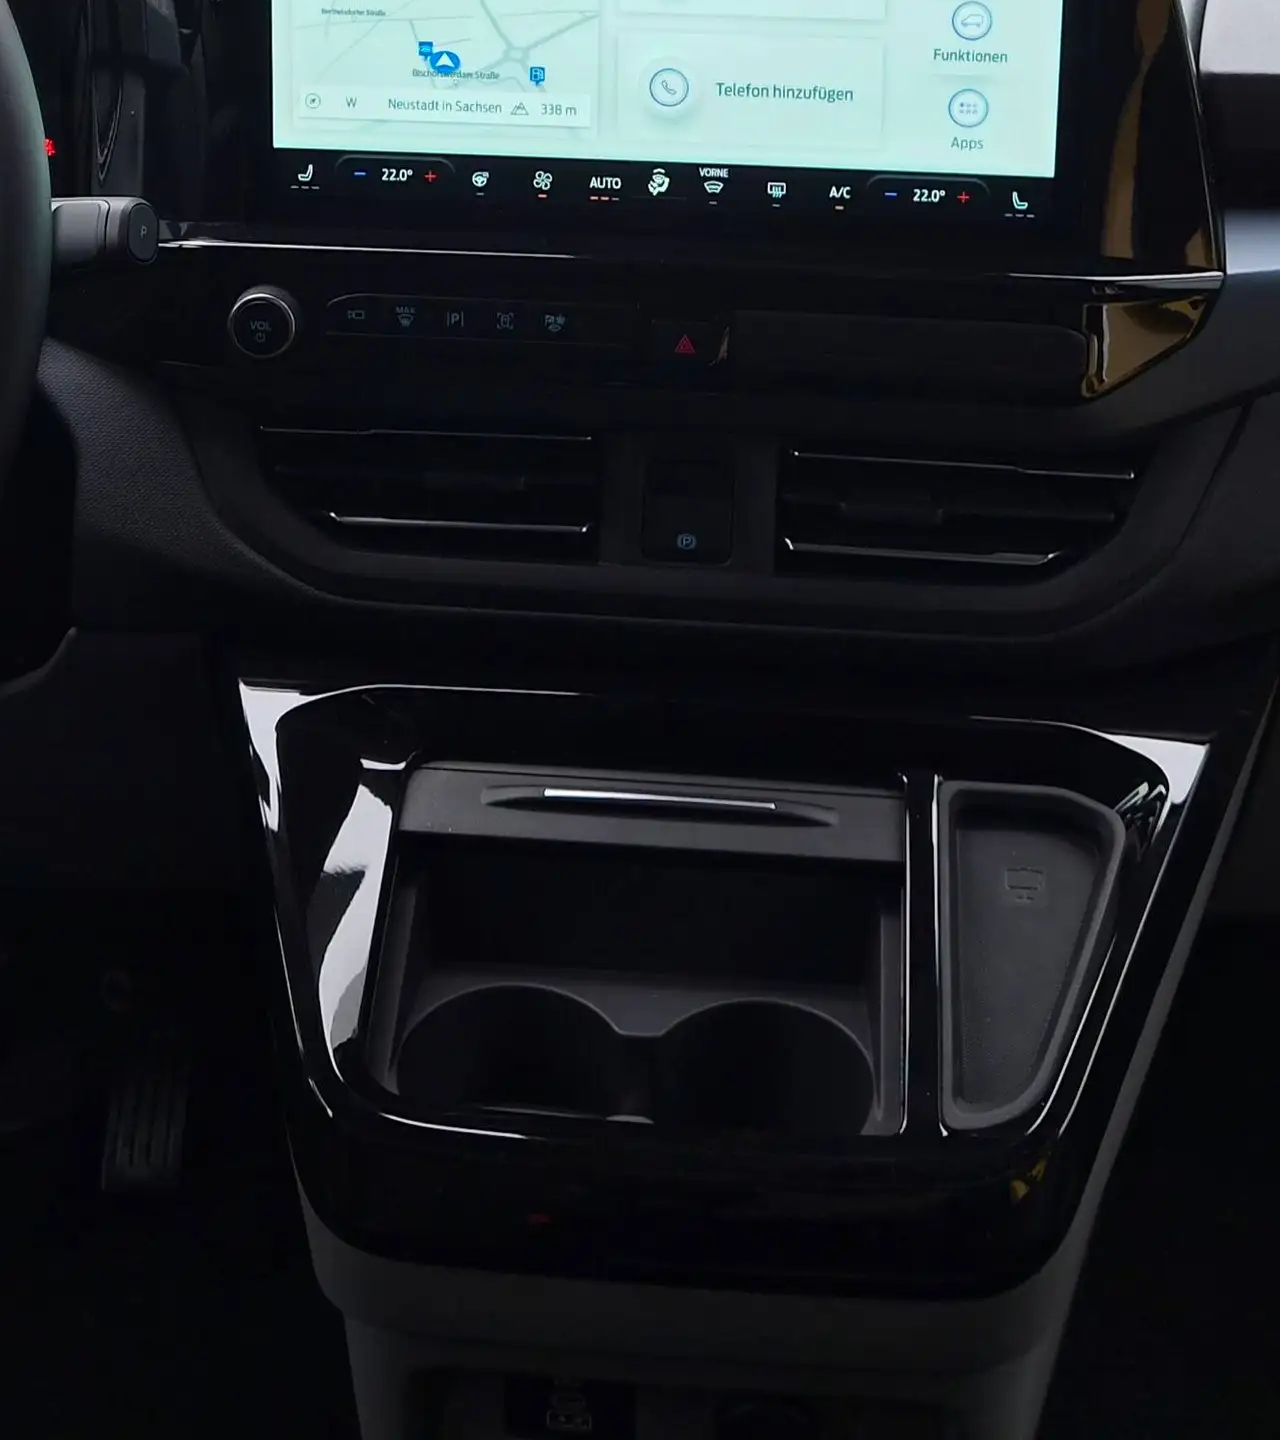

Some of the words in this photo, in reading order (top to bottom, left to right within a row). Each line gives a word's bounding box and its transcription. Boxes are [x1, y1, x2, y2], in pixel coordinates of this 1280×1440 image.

[933, 48, 1008, 64] Funktionen
[716, 83, 770, 98] Telefon
[772, 83, 854, 102] hinzufügen
[345, 97, 358, 108] W
[388, 98, 439, 111] Neustadt
[441, 98, 453, 111] in
[455, 100, 502, 113] Sachsen
[540, 103, 563, 116] 338
[566, 107, 577, 116] m
[950, 136, 984, 151] Apps
[381, 168, 413, 182] 22.0°
[698, 167, 729, 177] VORNE
[589, 177, 621, 189] AUTO
[829, 186, 851, 199] A/C
[912, 189, 946, 203] 22.0°
[250, 321, 272, 331] VOL
